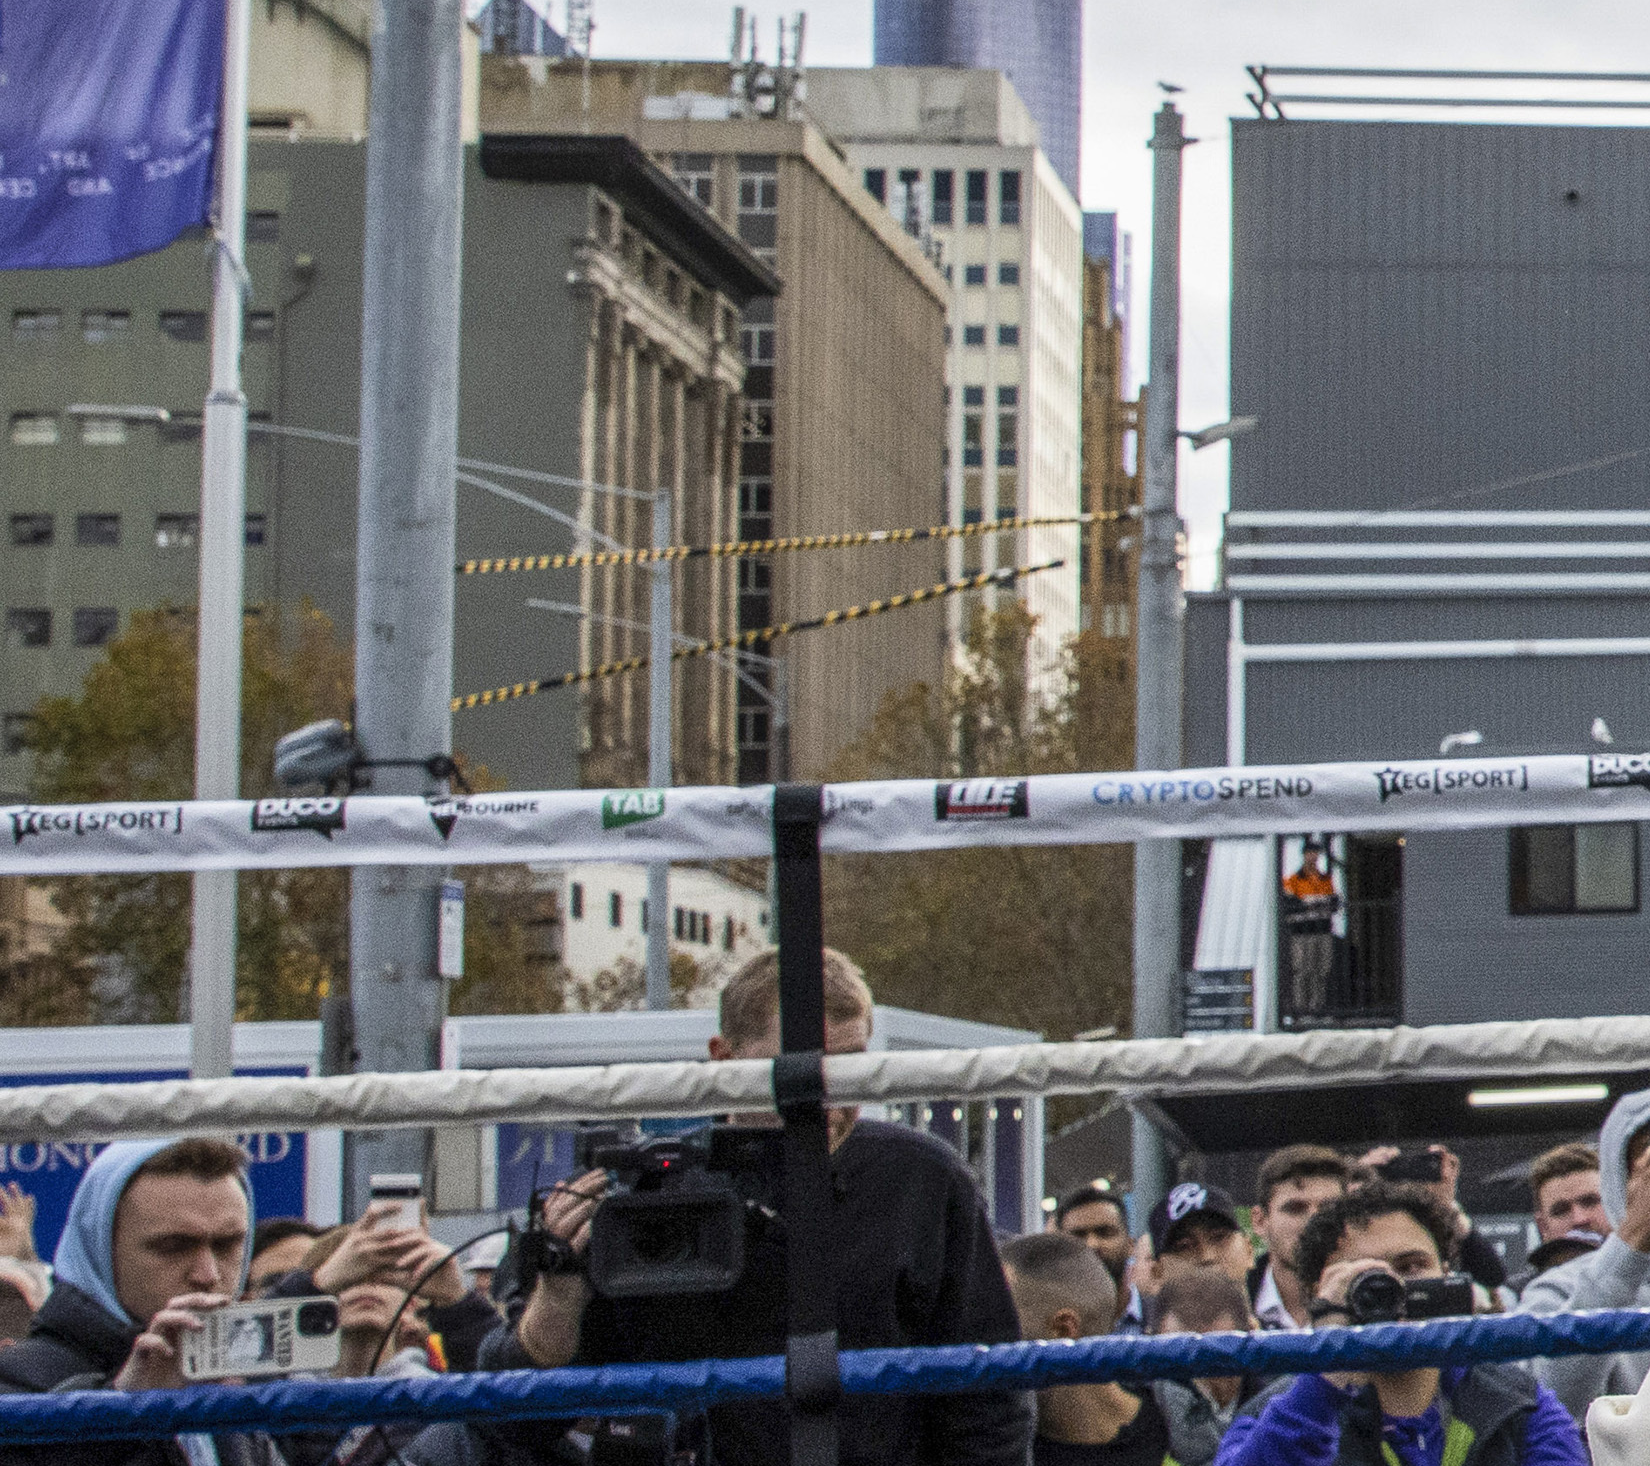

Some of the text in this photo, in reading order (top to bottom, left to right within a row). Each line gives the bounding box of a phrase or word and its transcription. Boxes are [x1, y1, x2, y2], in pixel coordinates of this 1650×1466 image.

[1092, 777, 1313, 805] CRYPTOSPEND
[257, 797, 340, 817] DUCO
[610, 793, 661, 815] TAB
